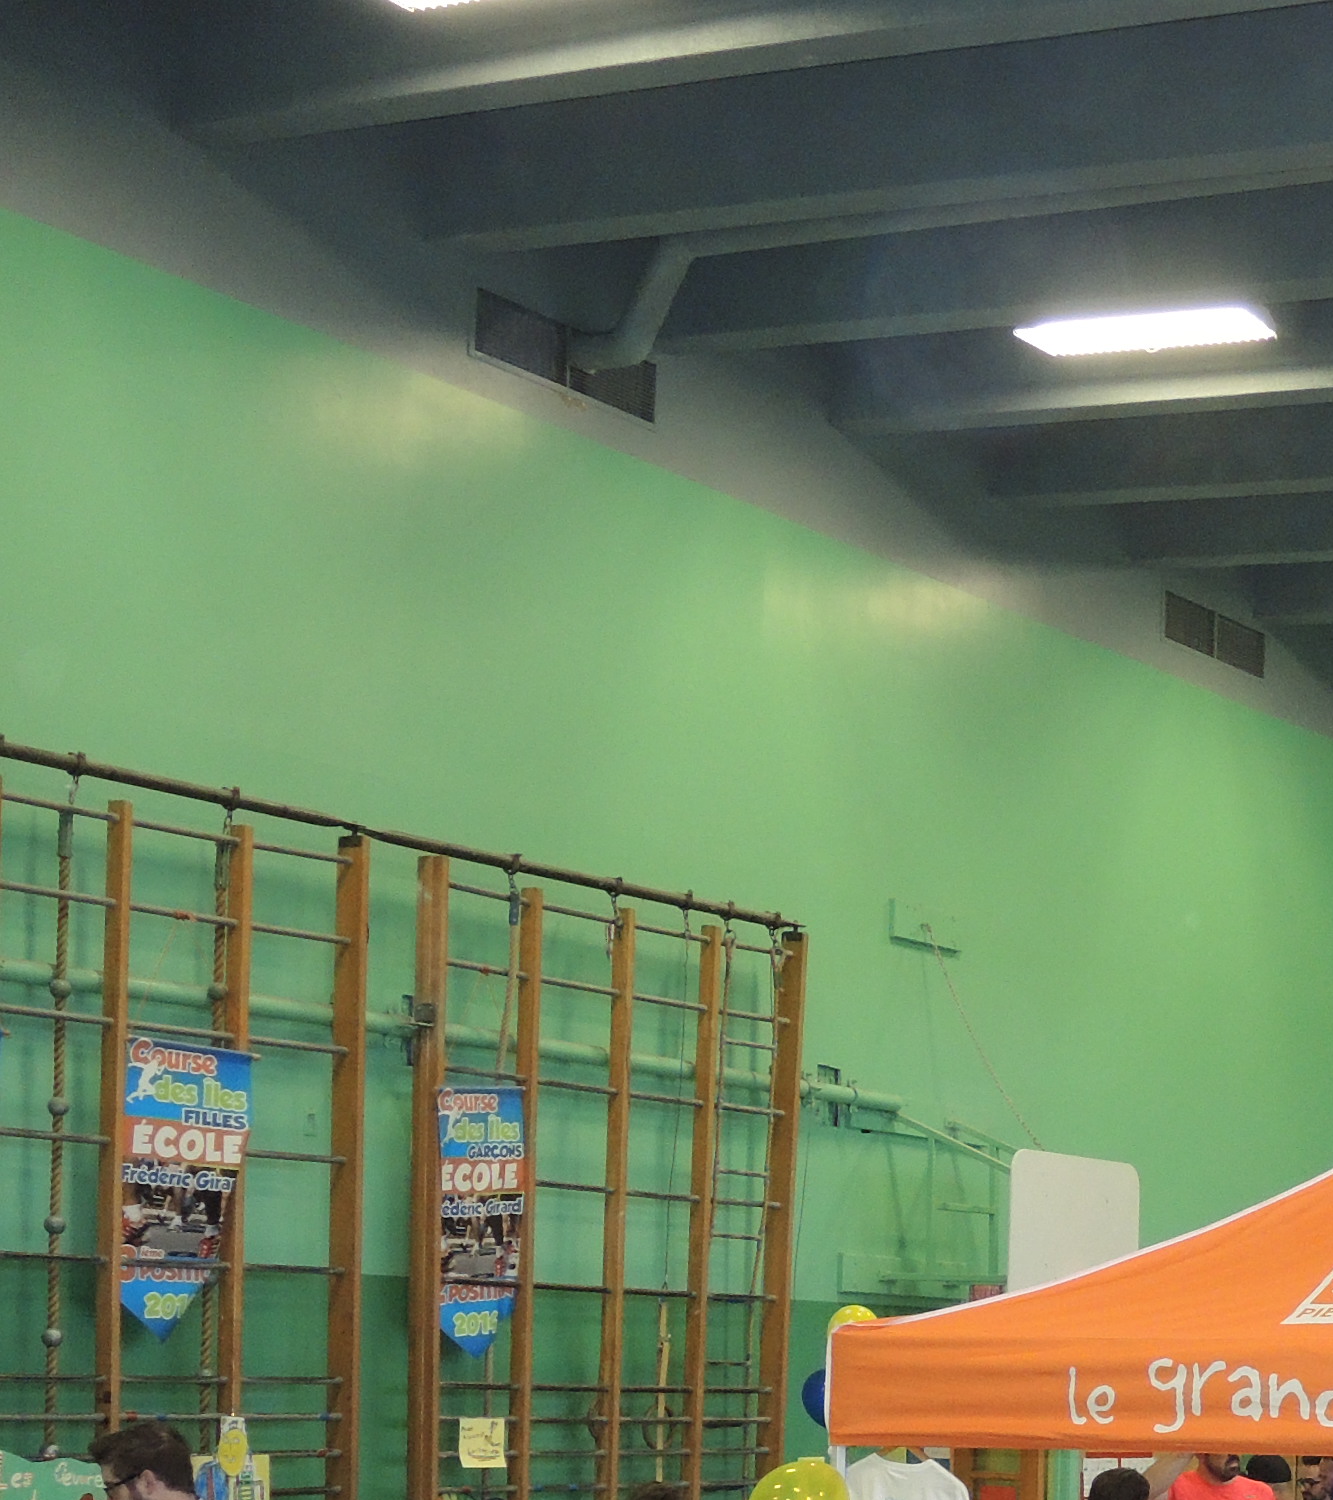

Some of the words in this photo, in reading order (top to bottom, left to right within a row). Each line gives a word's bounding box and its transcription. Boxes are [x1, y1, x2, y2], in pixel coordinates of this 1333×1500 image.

[130, 1037, 218, 1076] Course
[153, 1074, 198, 1106] des
[438, 1088, 499, 1113] Course
[182, 1107, 248, 1131] FILLES
[454, 1117, 484, 1143] des
[132, 1119, 242, 1164] ÉCOLE
[467, 1143, 524, 1162] GARÇONS
[441, 1160, 518, 1192] ÉCOLE
[441, 1199, 483, 1218] édéric
[485, 1195, 524, 1216] Girard
[1069, 1366, 1116, 1425] le
